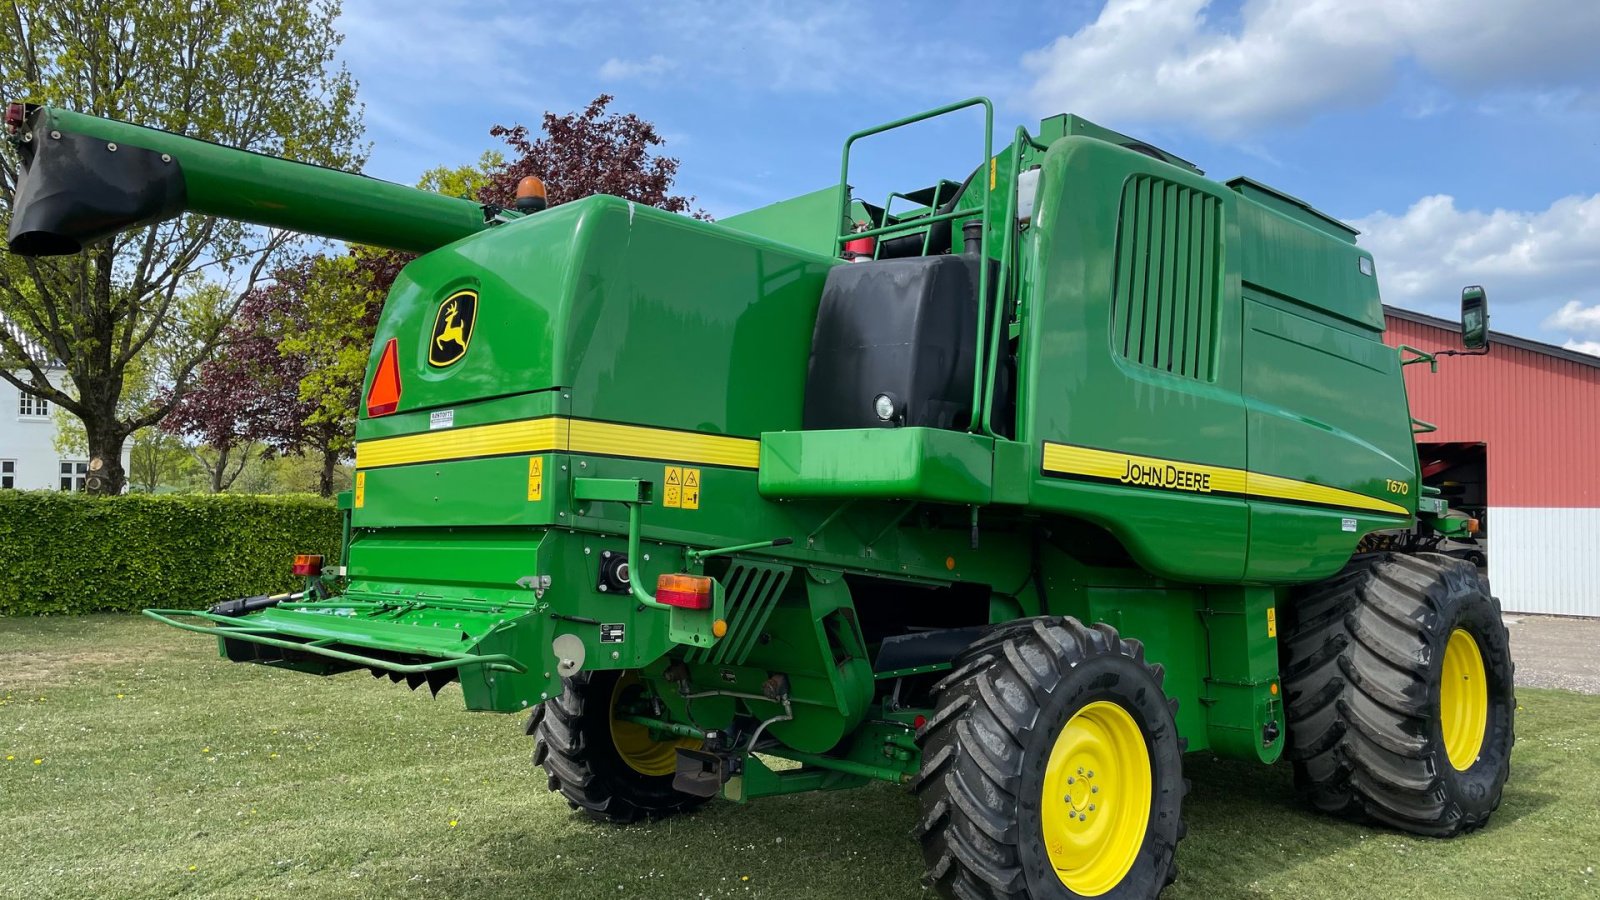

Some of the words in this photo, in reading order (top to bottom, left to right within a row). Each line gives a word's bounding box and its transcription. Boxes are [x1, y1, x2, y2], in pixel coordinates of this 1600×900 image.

[1121, 459, 1162, 485] JOHN
[1165, 465, 1211, 491] DEERE
[1386, 478, 1409, 495] T670
